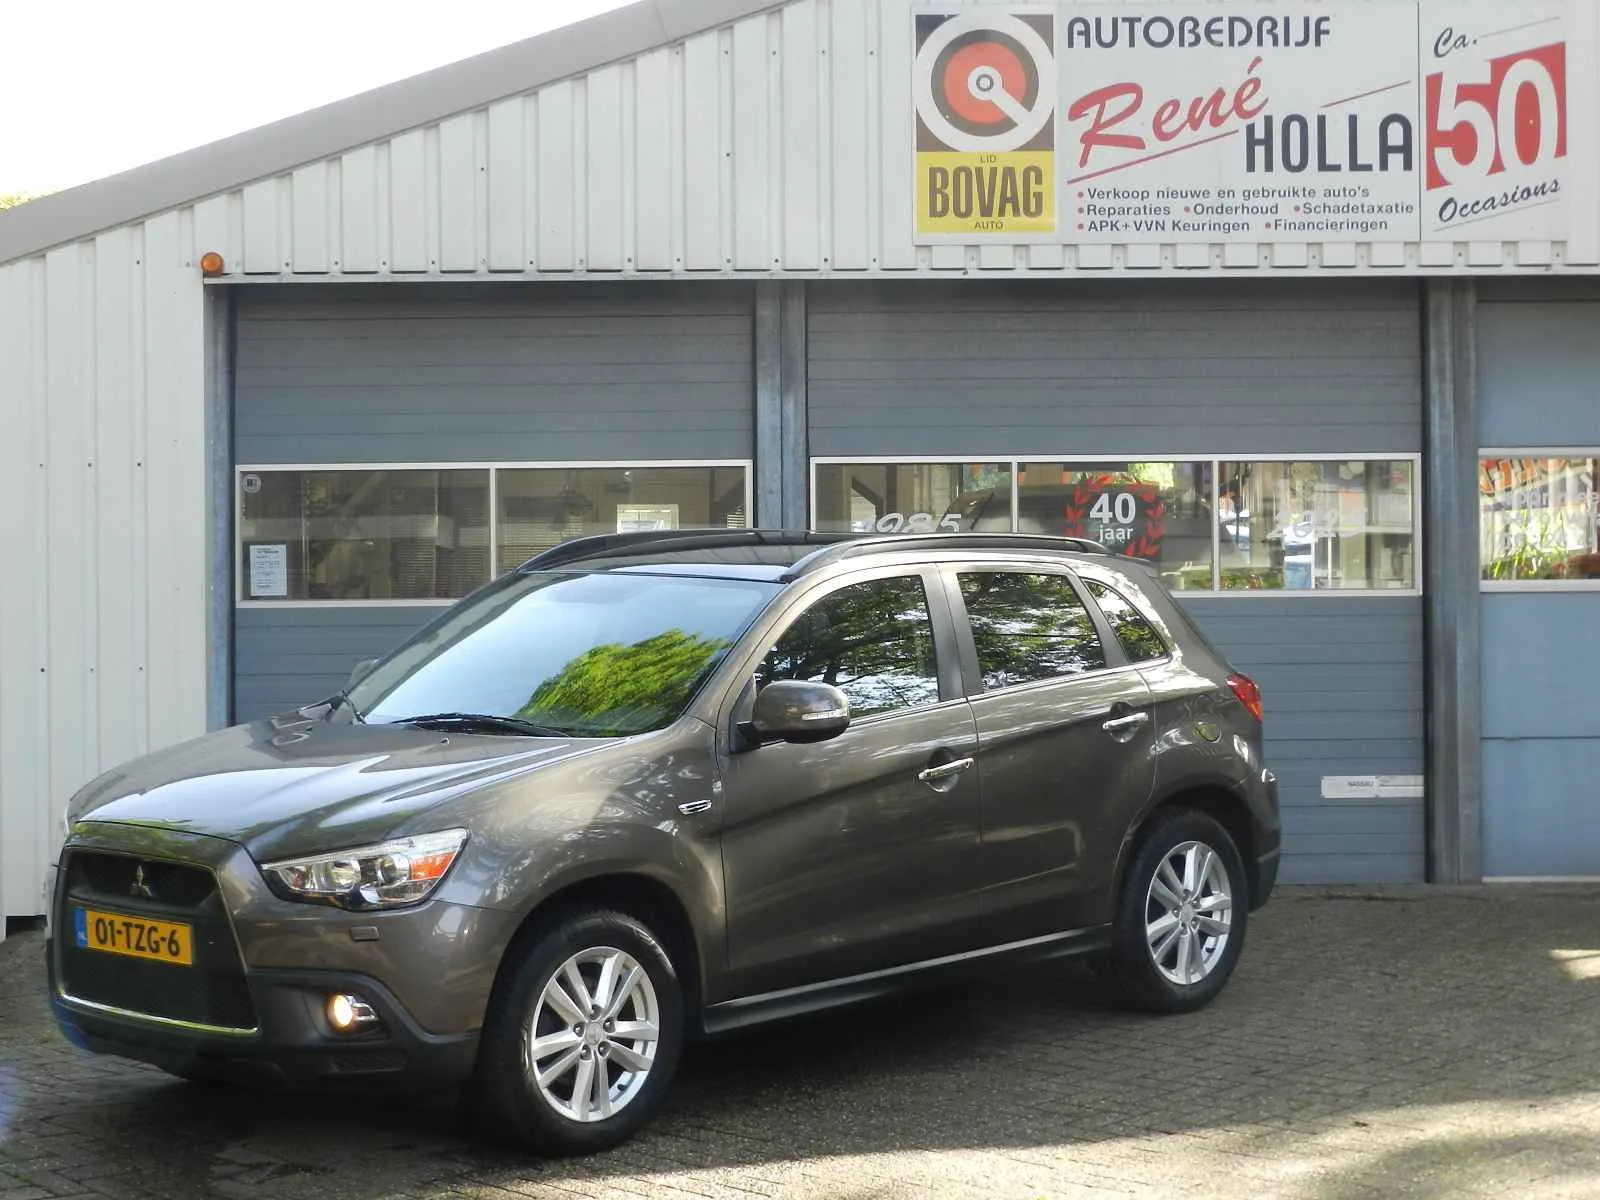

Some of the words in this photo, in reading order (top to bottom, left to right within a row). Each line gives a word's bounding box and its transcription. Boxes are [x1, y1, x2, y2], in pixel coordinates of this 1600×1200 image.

[1067, 16, 1331, 48] AUTOBEDRIJF
[1433, 27, 1478, 58] Ca.
[1067, 56, 1270, 168] René
[1433, 58, 1559, 187] 50
[979, 154, 997, 164] LID
[1245, 113, 1413, 173] HOLLA
[928, 165, 1043, 219] BOVAG
[1087, 187, 1150, 201] Verkoop
[1156, 187, 1210, 199] nieuwe
[1217, 189, 1236, 199] en
[1242, 186, 1317, 201] gebruikte
[1323, 186, 1370, 198] auto's
[1438, 178, 1561, 223] Occasions
[974, 221, 1004, 230] AUTO
[1087, 204, 1171, 217] Reparaties
[1193, 203, 1279, 215] Onderhoud
[1302, 202, 1414, 215] Schadetaxatie
[1171, 219, 1250, 233] Keuringen
[1274, 218, 1388, 232] Financieringen
[1089, 492, 1136, 524] 40
[1099, 524, 1134, 543] jaar
[95, 917, 180, 957] 01-TZG-6
